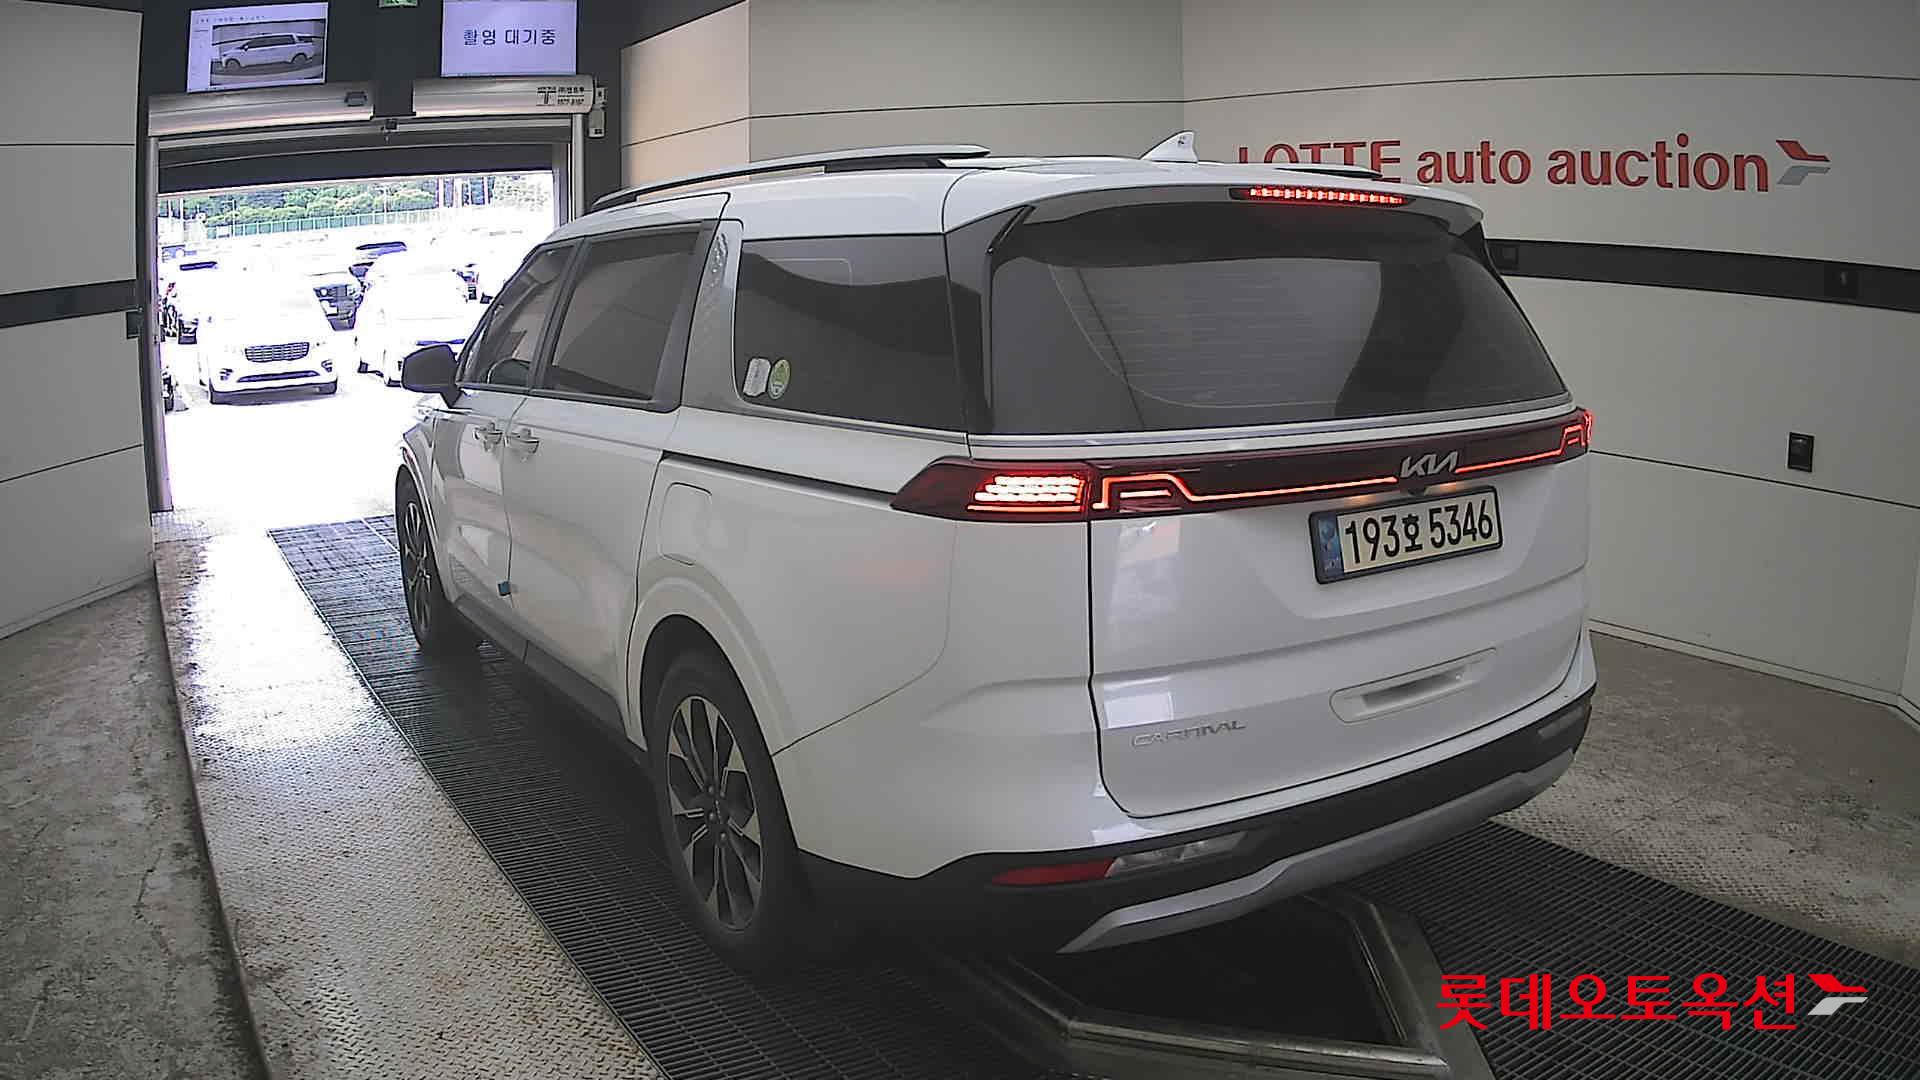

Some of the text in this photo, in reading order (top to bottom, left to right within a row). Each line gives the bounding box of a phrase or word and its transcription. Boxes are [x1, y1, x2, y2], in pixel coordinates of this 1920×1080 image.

[504, 28, 556, 45] 대기중
[1416, 140, 1532, 185] auto
[1547, 133, 1769, 192] auction
